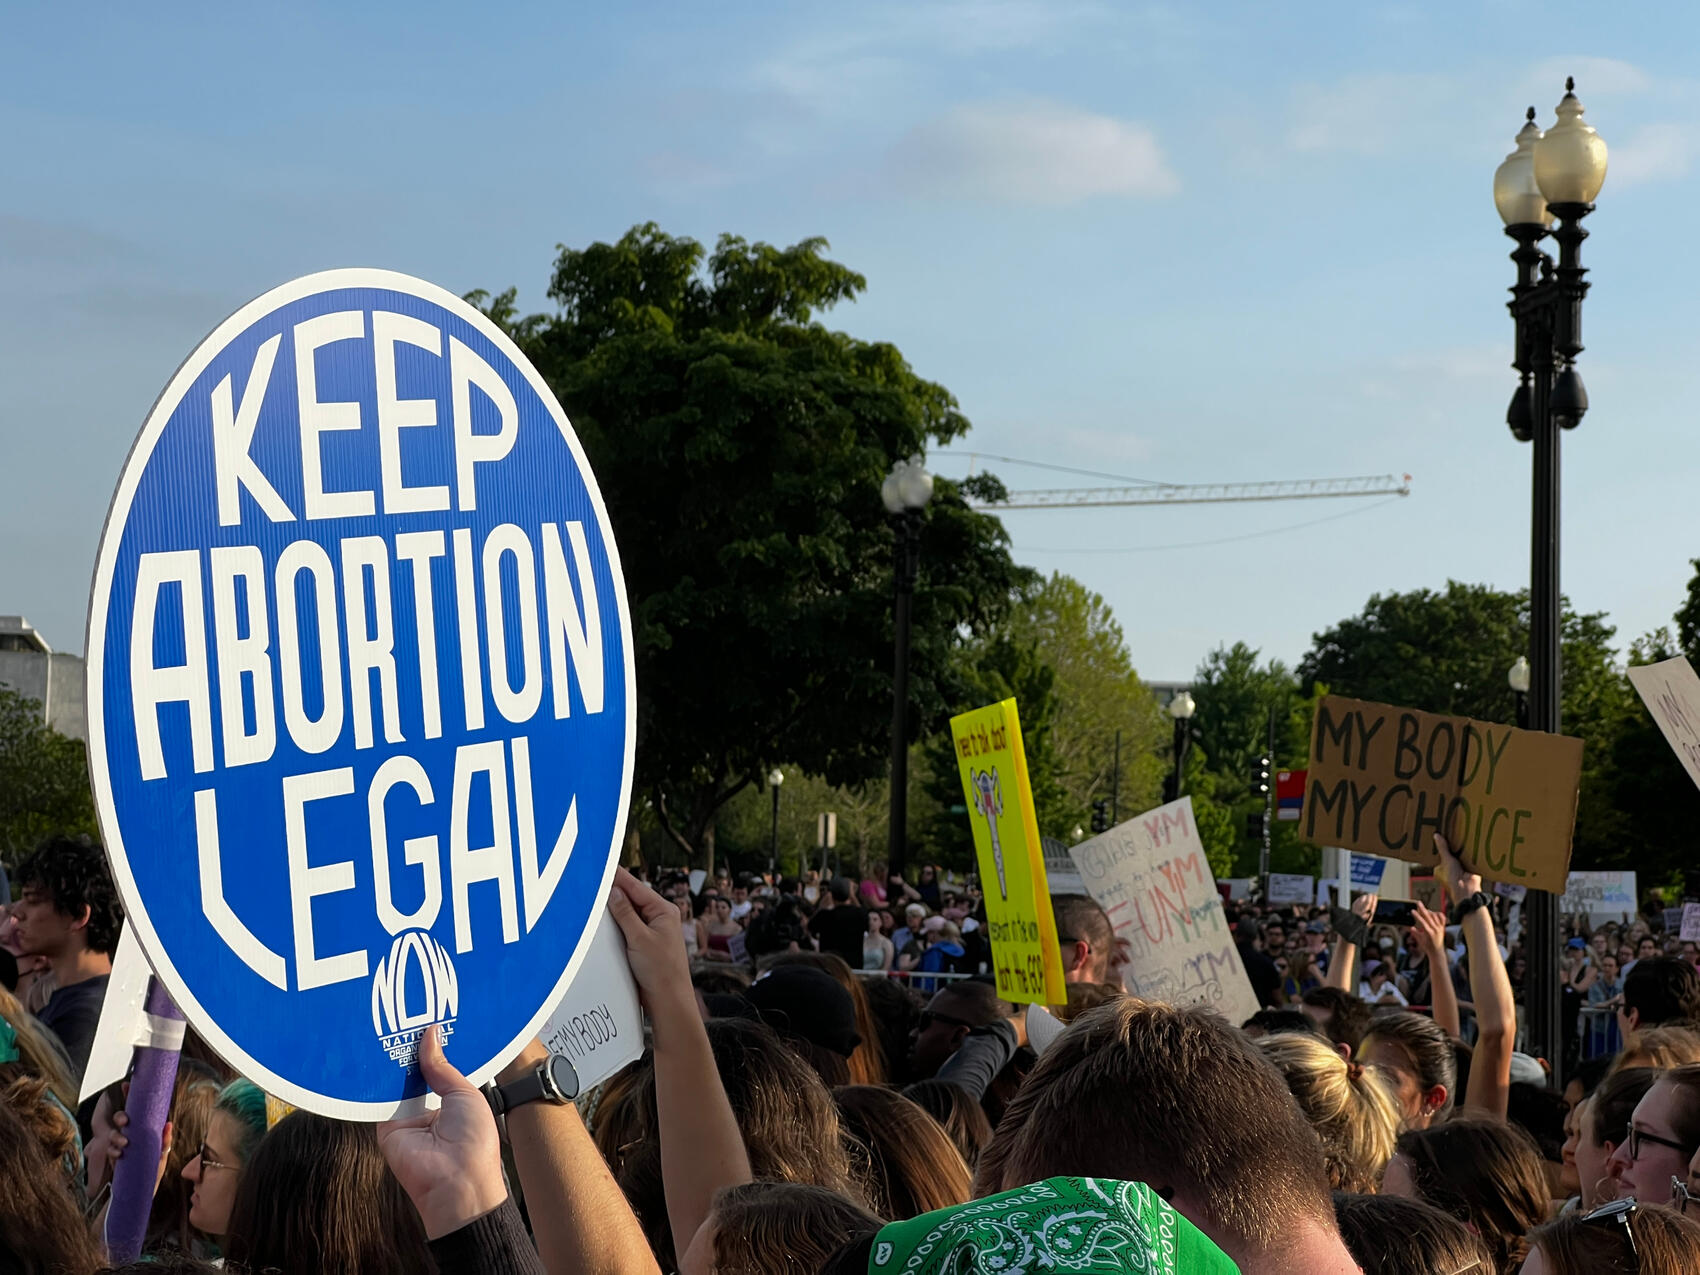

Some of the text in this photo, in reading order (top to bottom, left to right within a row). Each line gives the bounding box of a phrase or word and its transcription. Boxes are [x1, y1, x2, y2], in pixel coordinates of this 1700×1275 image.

[211, 310, 518, 527] KEEP
[130, 521, 603, 781] ABORTION
[1307, 779, 1537, 878] MY CHOICE.
[1316, 706, 1512, 795] MY BODY
[194, 736, 578, 992] LEGAL
[371, 932, 459, 1037] NOW
